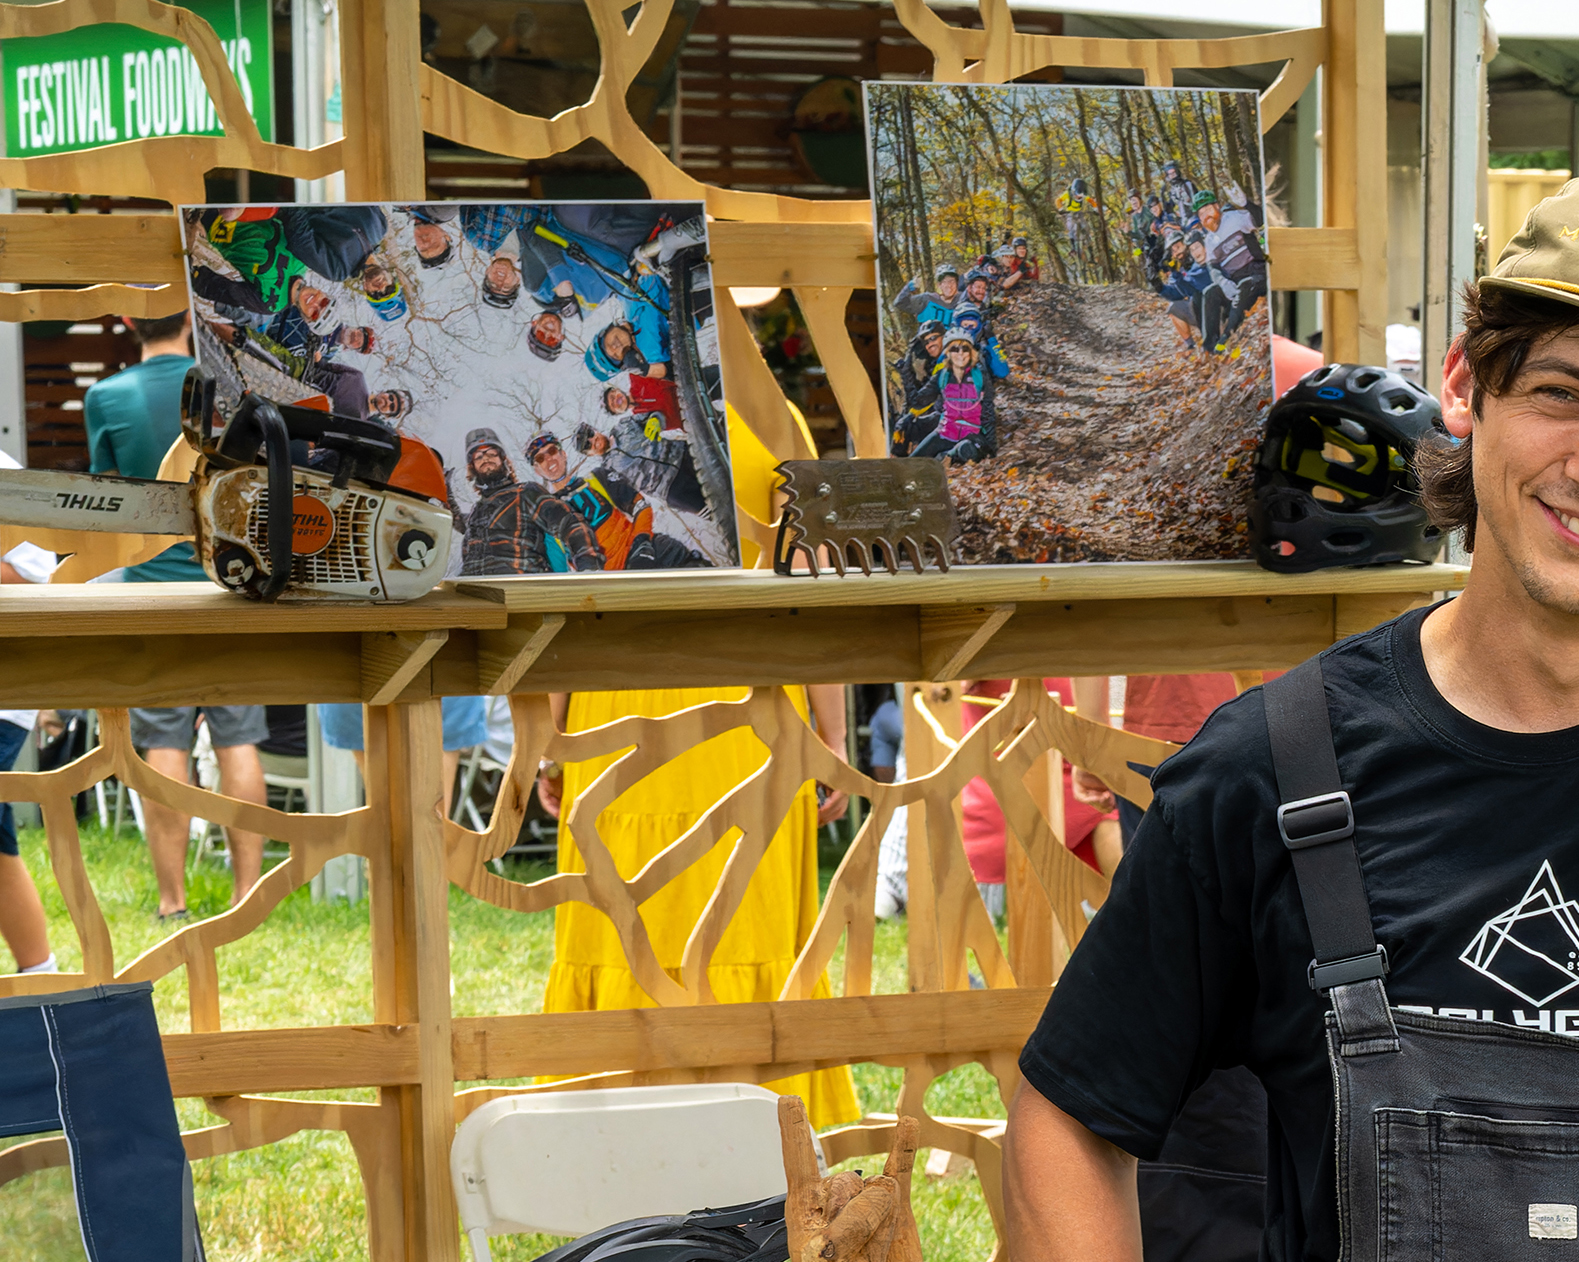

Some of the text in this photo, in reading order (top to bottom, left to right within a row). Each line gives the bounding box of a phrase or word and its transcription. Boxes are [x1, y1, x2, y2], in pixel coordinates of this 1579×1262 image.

[17, 56, 117, 149] FESTIVAL
[56, 493, 124, 512] STIHL
[292, 513, 328, 527] TIHL
